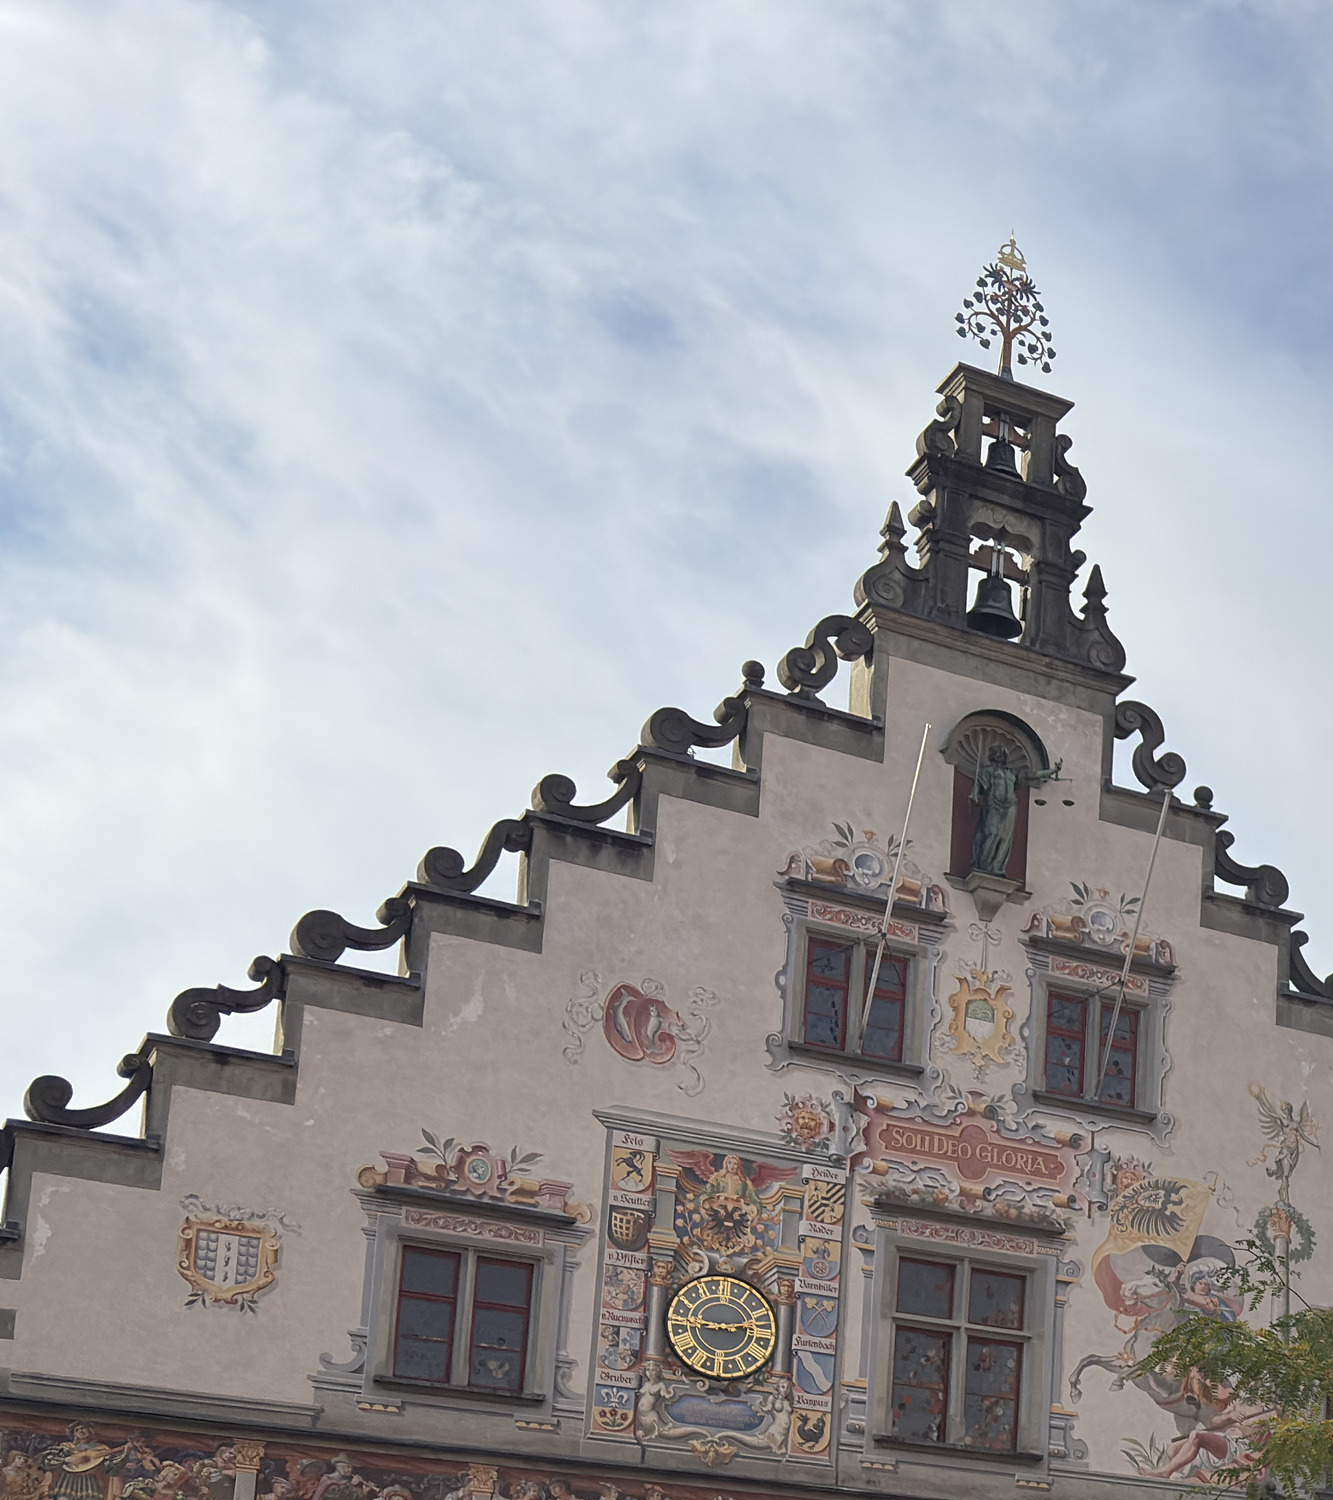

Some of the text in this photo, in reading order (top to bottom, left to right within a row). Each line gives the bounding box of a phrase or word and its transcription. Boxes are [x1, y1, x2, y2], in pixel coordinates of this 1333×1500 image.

[892, 1128, 1049, 1175] SOLI DEO GLORIA
